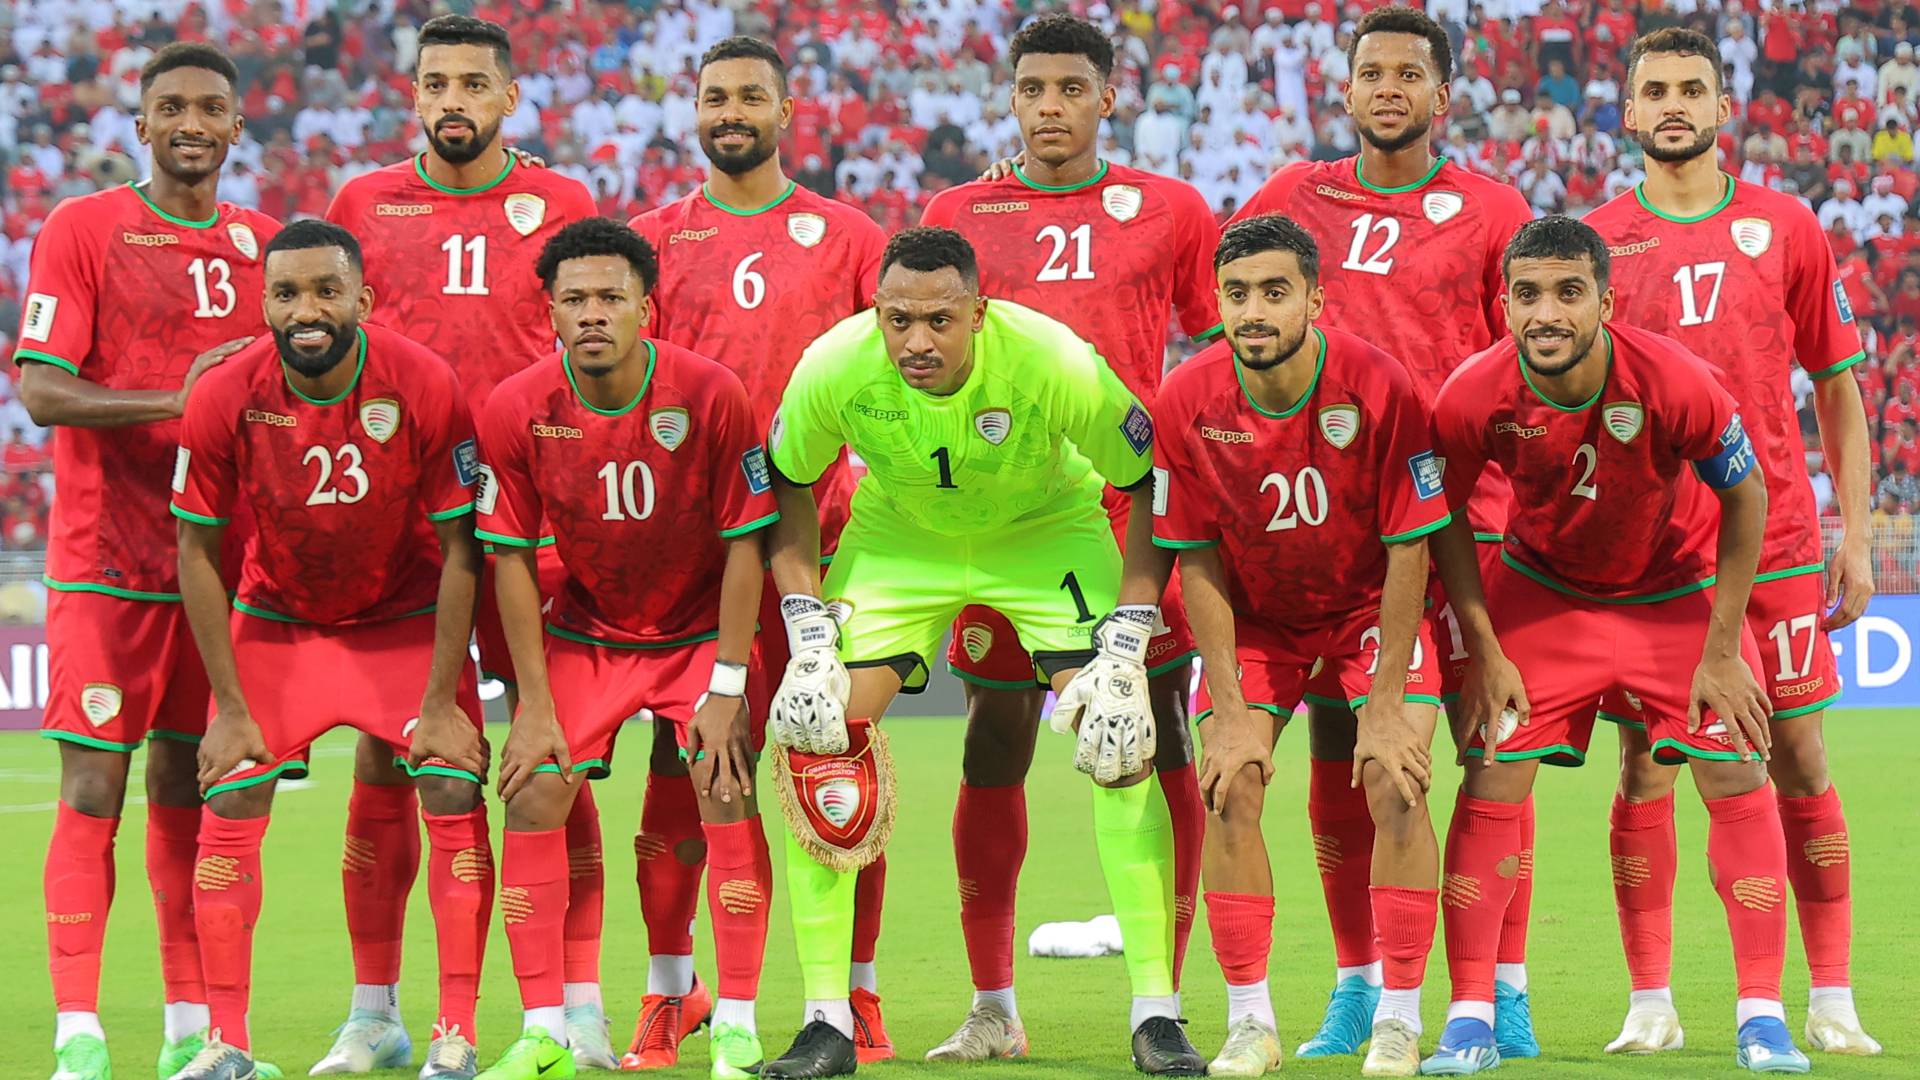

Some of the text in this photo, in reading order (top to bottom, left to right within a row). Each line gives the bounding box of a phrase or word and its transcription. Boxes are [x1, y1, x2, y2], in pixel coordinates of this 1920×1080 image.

[376, 203, 433, 216] Kappa
[973, 201, 1029, 214] Kappa
[1316, 184, 1366, 201] Kappa
[123, 232, 179, 246] Kappa
[441, 234, 490, 295] 11
[1035, 224, 1095, 282] 21
[1341, 213, 1400, 275] 12
[187, 258, 236, 318] 13
[732, 251, 765, 310] 6
[1672, 261, 1727, 326] 17
[246, 409, 297, 426] Kappa
[532, 424, 583, 439] Kappa
[855, 402, 909, 421] Kappa
[1201, 426, 1254, 443] Kappa
[302, 444, 370, 507] 23
[597, 460, 655, 521] 10
[929, 446, 958, 488] 1
[1570, 443, 1598, 501] 2
[1259, 466, 1329, 532] 20
[1059, 571, 1096, 624] 1
[1147, 640, 1176, 659] ppa
[1767, 613, 1818, 681] 17
[1776, 677, 1823, 698] Kappa
